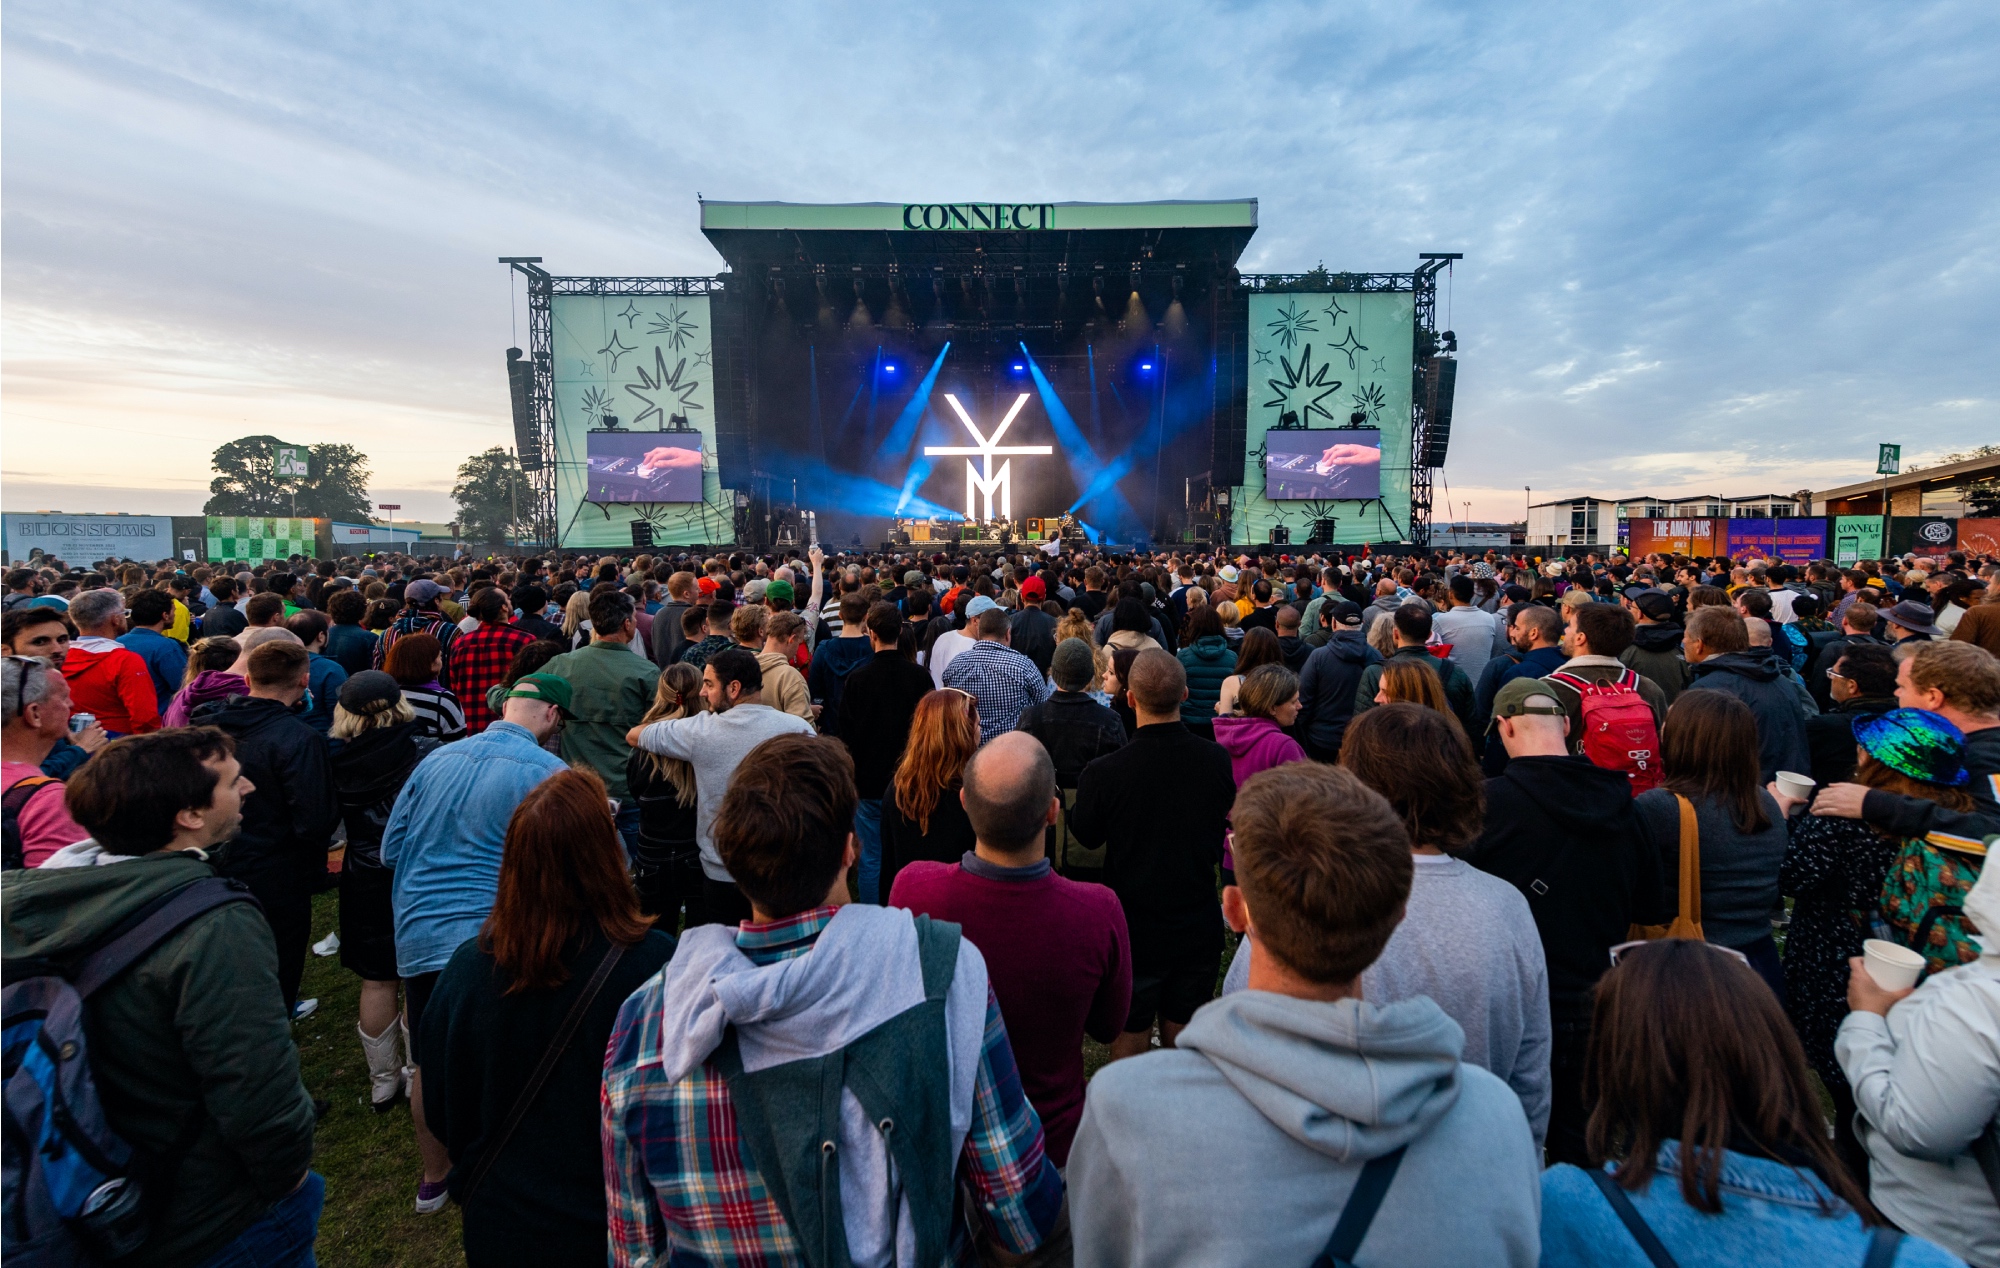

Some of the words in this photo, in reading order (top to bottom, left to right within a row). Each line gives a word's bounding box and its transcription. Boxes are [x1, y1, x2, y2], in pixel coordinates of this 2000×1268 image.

[903, 204, 1054, 230] CONNECT
[20, 523, 155, 536] BLOSSOMS
[1653, 520, 1668, 537] THE
[1669, 520, 1711, 537] AMAZONS
[1837, 523, 1881, 534] CONNECT
